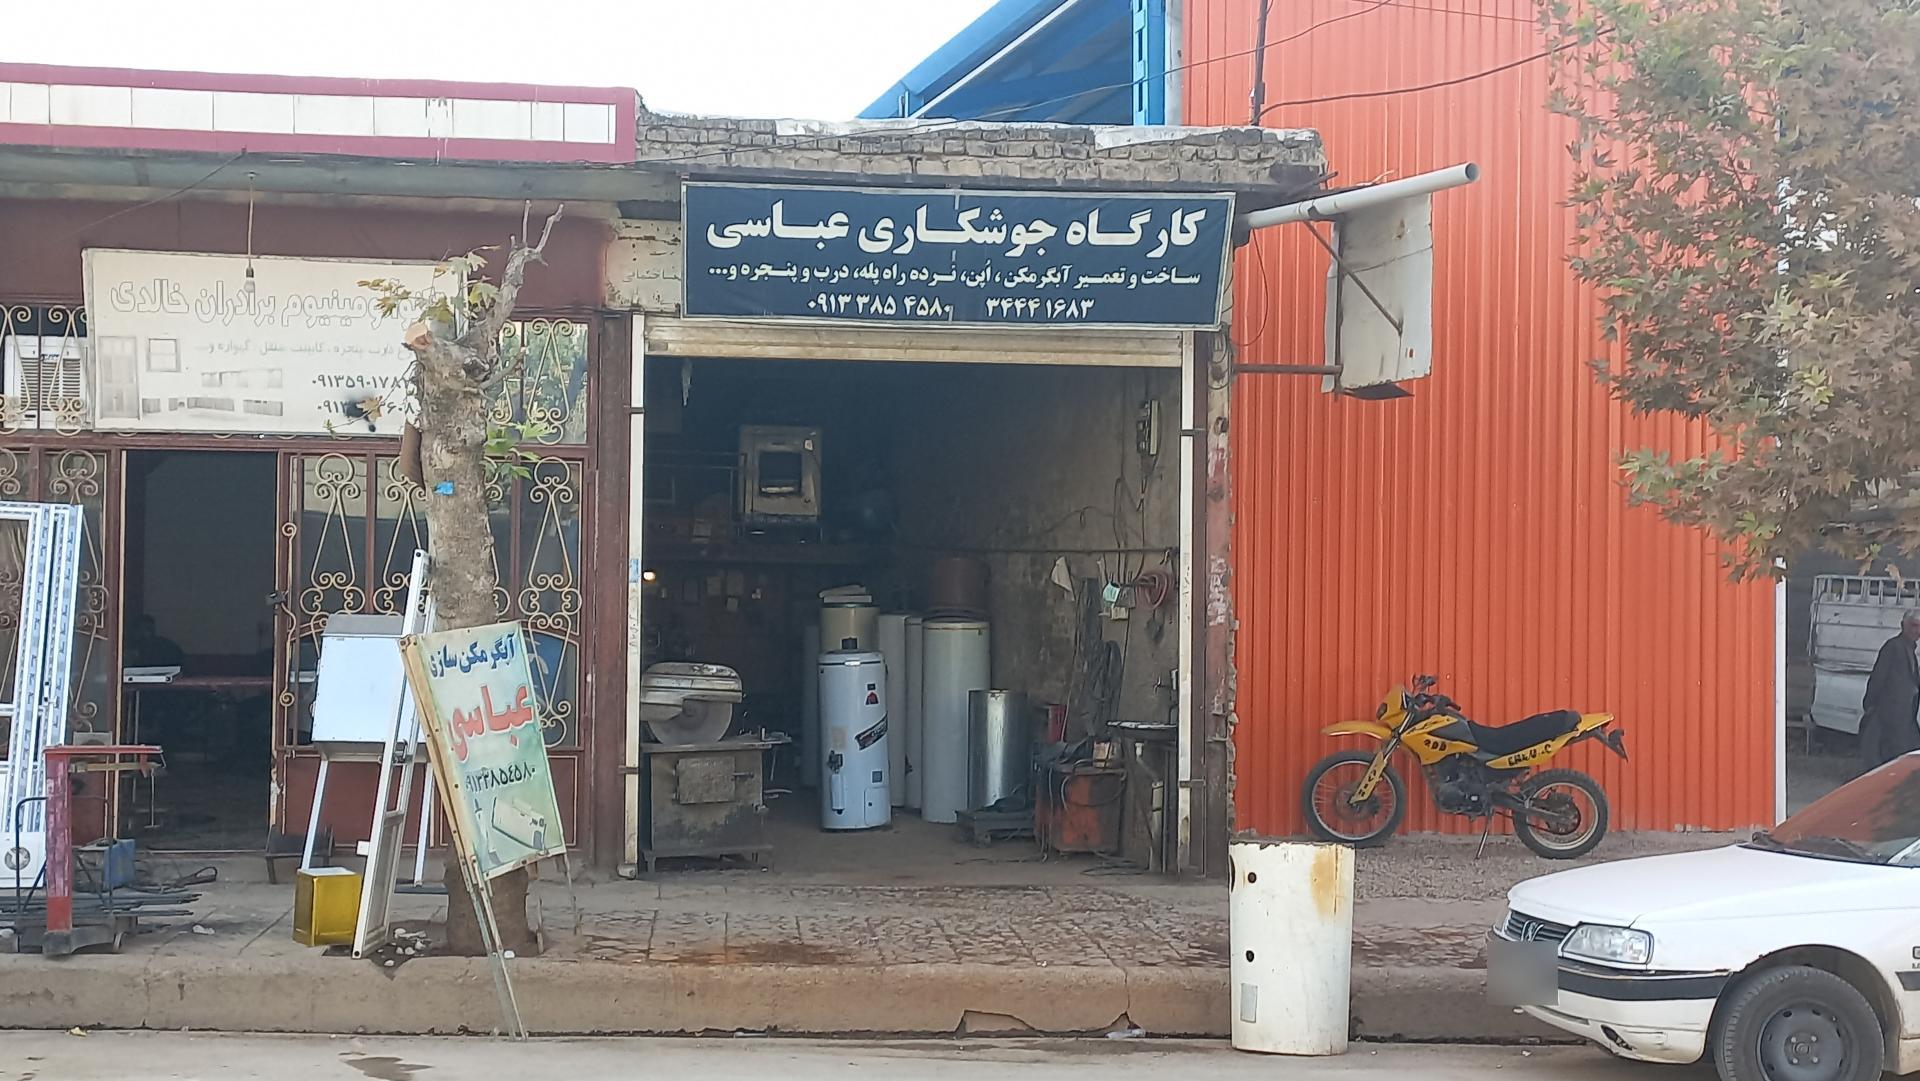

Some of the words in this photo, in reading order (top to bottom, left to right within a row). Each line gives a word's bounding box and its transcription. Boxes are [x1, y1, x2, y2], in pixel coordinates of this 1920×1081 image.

[706, 200, 850, 250] عباسی
[858, 203, 1057, 257] جوشکاری
[1066, 207, 1207, 258] کارگاه
[740, 262, 798, 284] پنجره
[800, 267, 809, 284] و
[813, 264, 850, 284] درب
[882, 263, 906, 285] راه
[1073, 267, 1126, 289] تعمیر
[1126, 273, 1137, 289] و
[1140, 267, 1201, 285] ساخت
[110, 279, 190, 313] خالدی
[194, 280, 276, 327] برادران
[807, 292, 852, 315] ۰۹۱۳
[855, 293, 897, 316] ۳۸۵
[903, 295, 951, 317] ۴۵۸۰
[985, 297, 1041, 318] ۳۴۴۴
[1045, 298, 1095, 319] ۱۶۸۳
[448, 683, 534, 763] عباسی
